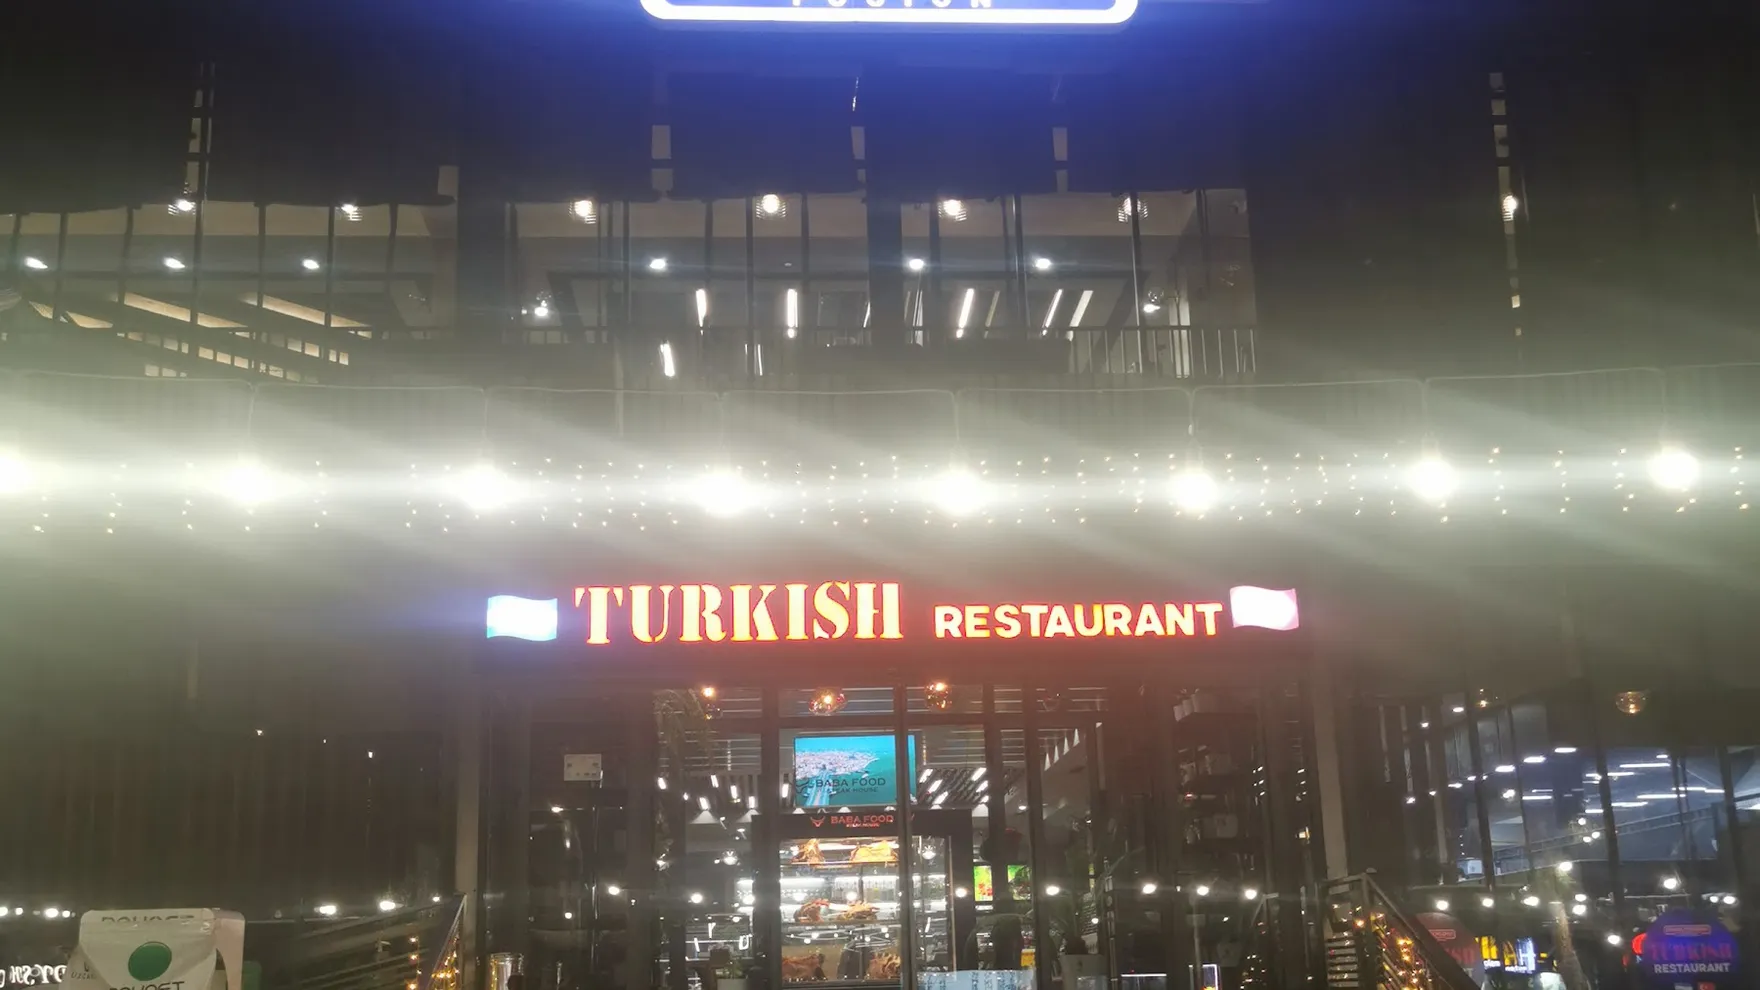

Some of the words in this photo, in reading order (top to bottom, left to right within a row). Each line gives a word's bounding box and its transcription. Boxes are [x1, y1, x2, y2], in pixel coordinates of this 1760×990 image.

[574, 581, 904, 645] TURKISH
[934, 602, 1223, 639] RESTAURANT
[816, 779, 848, 787] BABA
[852, 778, 886, 786] FOOD
[831, 816, 861, 824] BABA
[863, 815, 894, 823] FOOD
[1653, 962, 1731, 974] RESTAURANT
